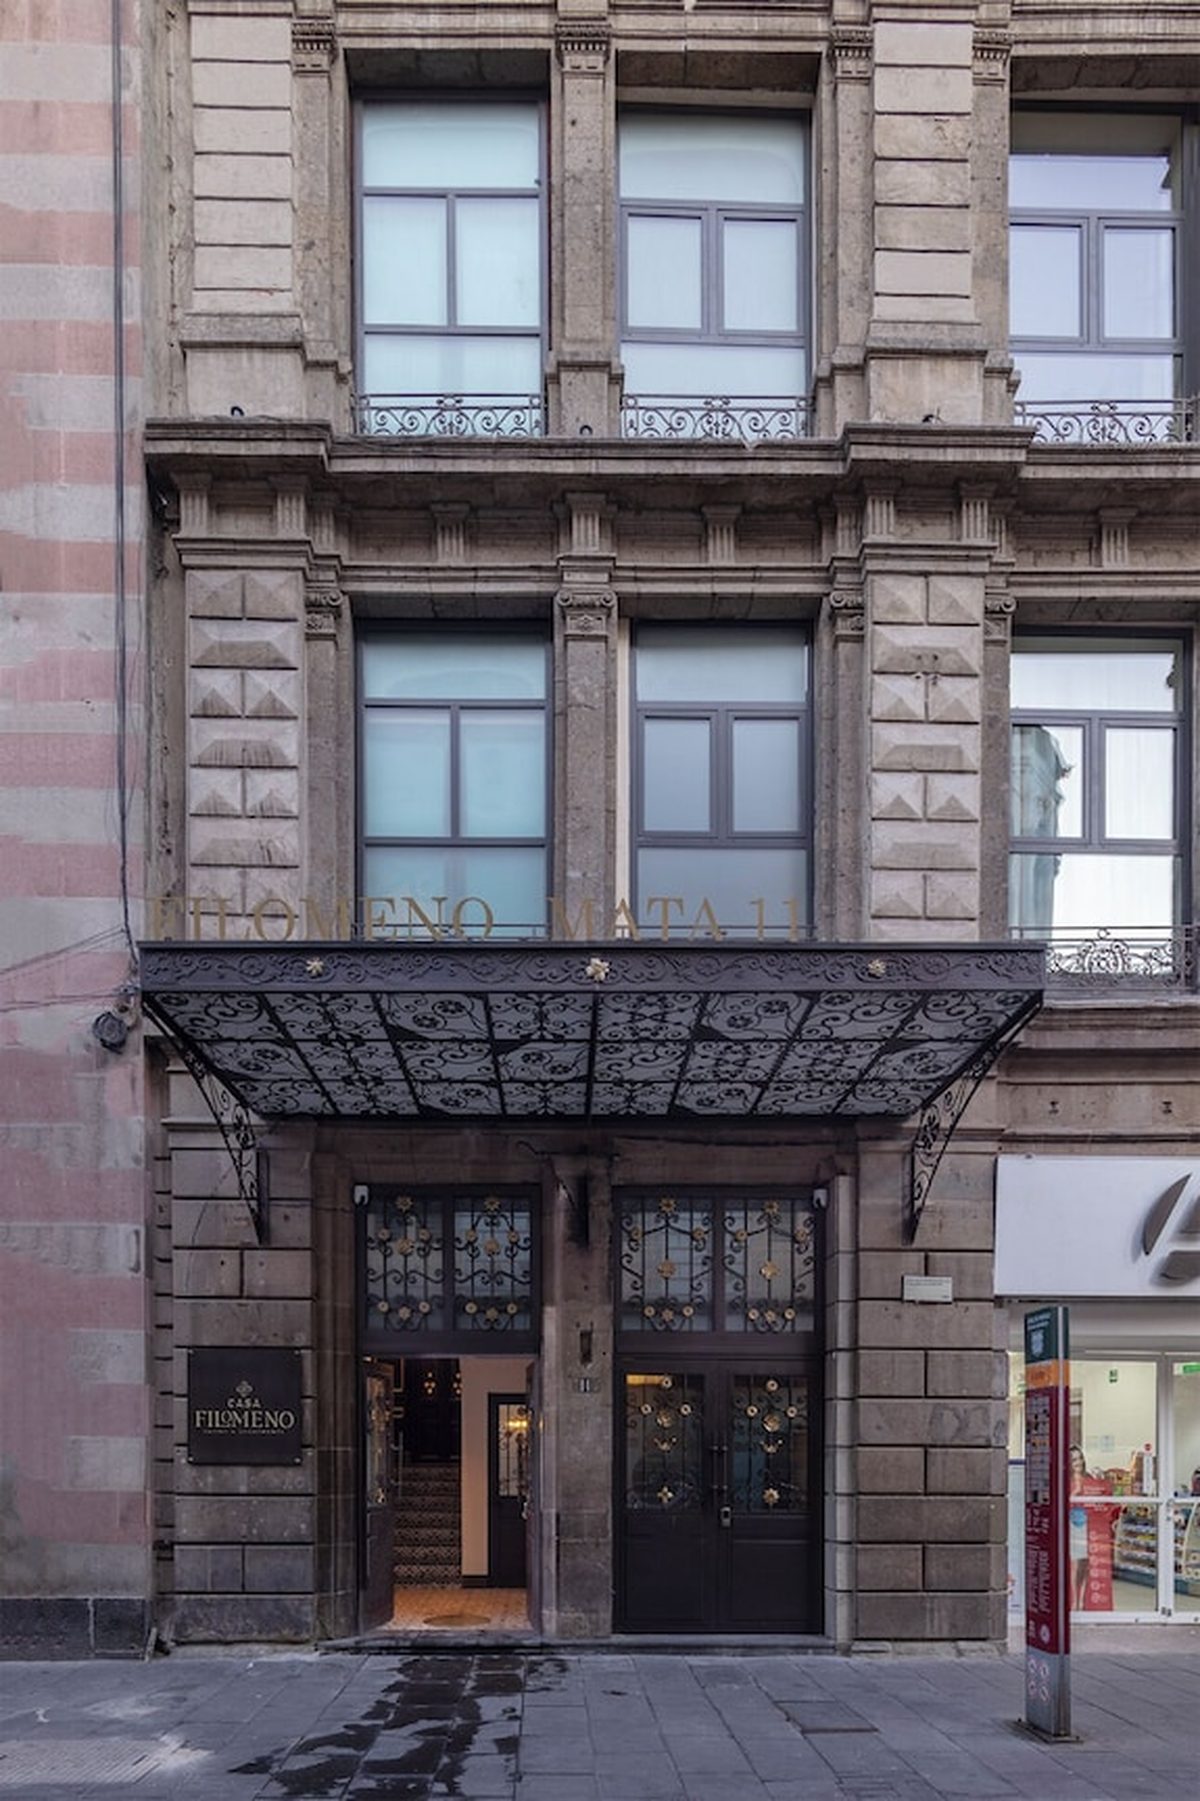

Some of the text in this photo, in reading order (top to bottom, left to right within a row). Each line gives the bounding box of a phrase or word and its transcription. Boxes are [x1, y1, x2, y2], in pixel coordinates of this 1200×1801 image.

[146, 895, 799, 942] FILOMENO MATA 11
[227, 1397, 262, 1409] CASA
[195, 1410, 295, 1429] FILOMENO
